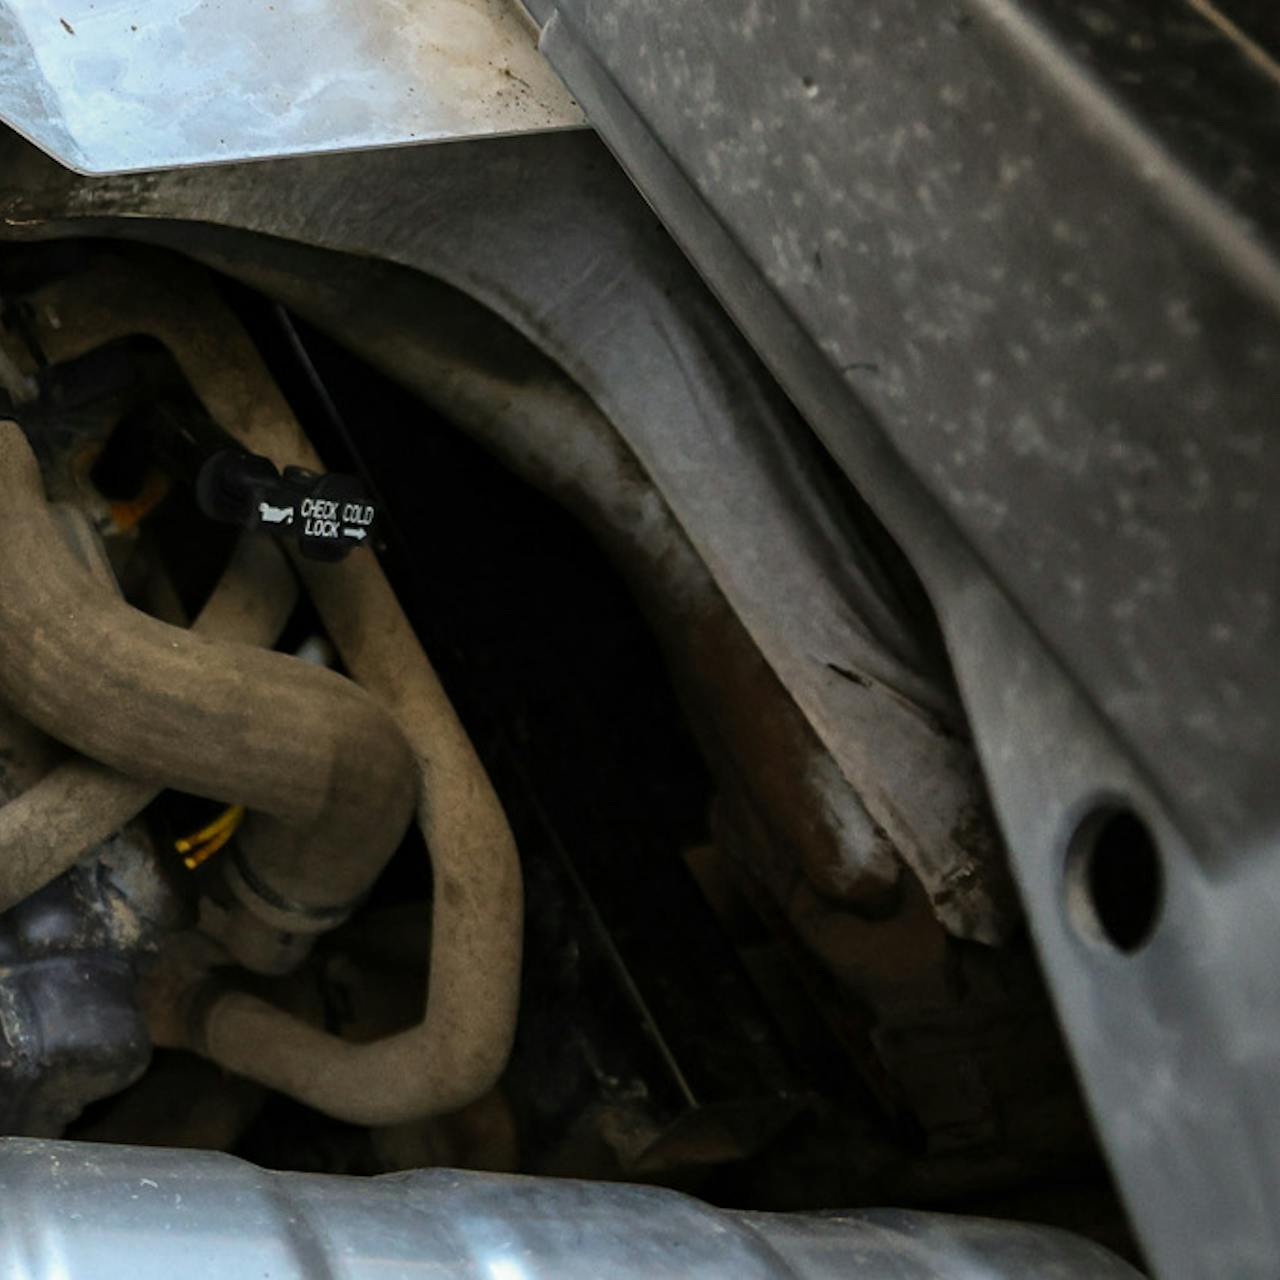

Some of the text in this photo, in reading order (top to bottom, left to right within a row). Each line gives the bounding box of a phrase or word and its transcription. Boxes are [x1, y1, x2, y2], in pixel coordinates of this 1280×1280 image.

[301, 499, 374, 525] CHECK COLD
[305, 519, 340, 538] LOCK
